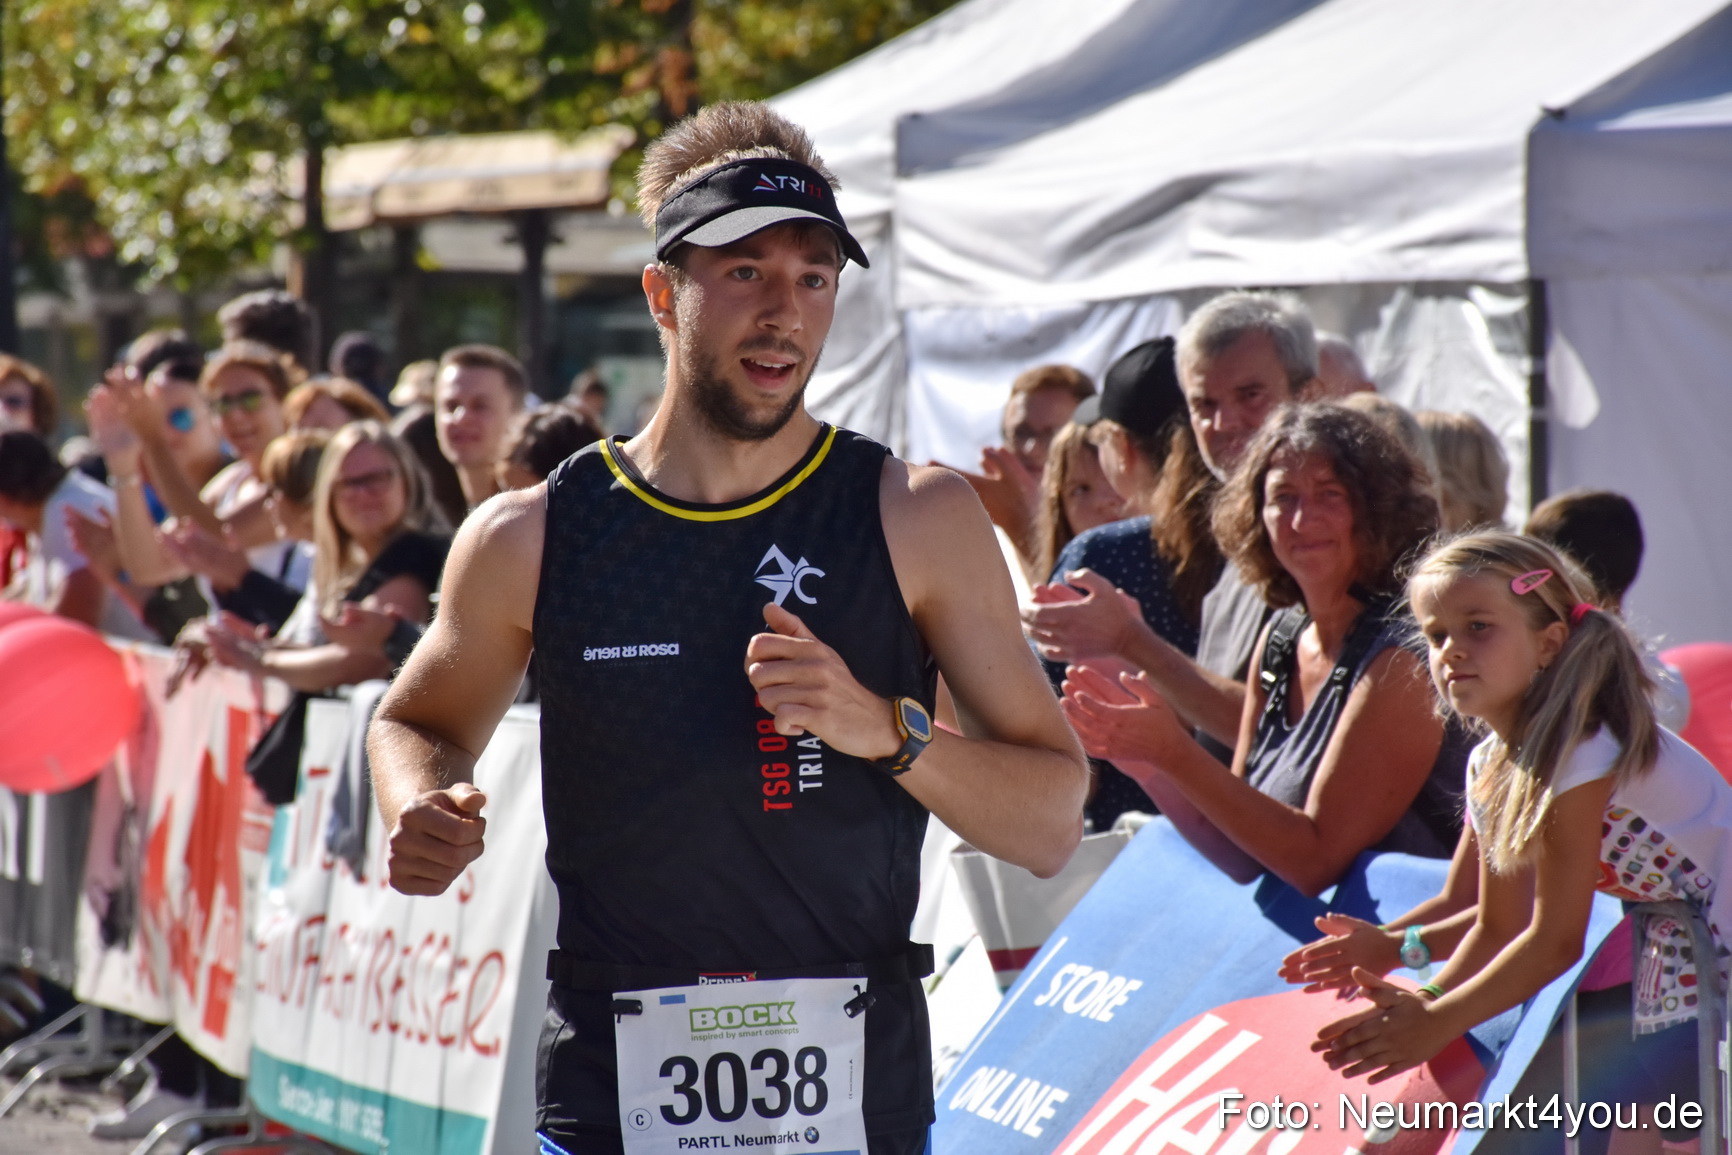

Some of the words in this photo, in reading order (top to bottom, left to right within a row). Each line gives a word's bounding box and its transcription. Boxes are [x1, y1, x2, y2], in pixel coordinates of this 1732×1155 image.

[761, 763, 793, 812] TSG
[797, 736, 823, 792] TRIA
[689, 1001, 798, 1032] BOCK
[1034, 963, 1143, 1022] STORE
[691, 1032, 724, 1042] inspired
[726, 1031, 736, 1040] by
[738, 1029, 763, 1038] smart
[765, 1027, 800, 1036] concepts
[659, 1046, 829, 1126] 3038
[949, 1066, 1069, 1138] ONLINE
[635, 1114, 645, 1126] C
[678, 1136, 731, 1149] PARTL
[734, 1131, 800, 1147] Neumarkt
